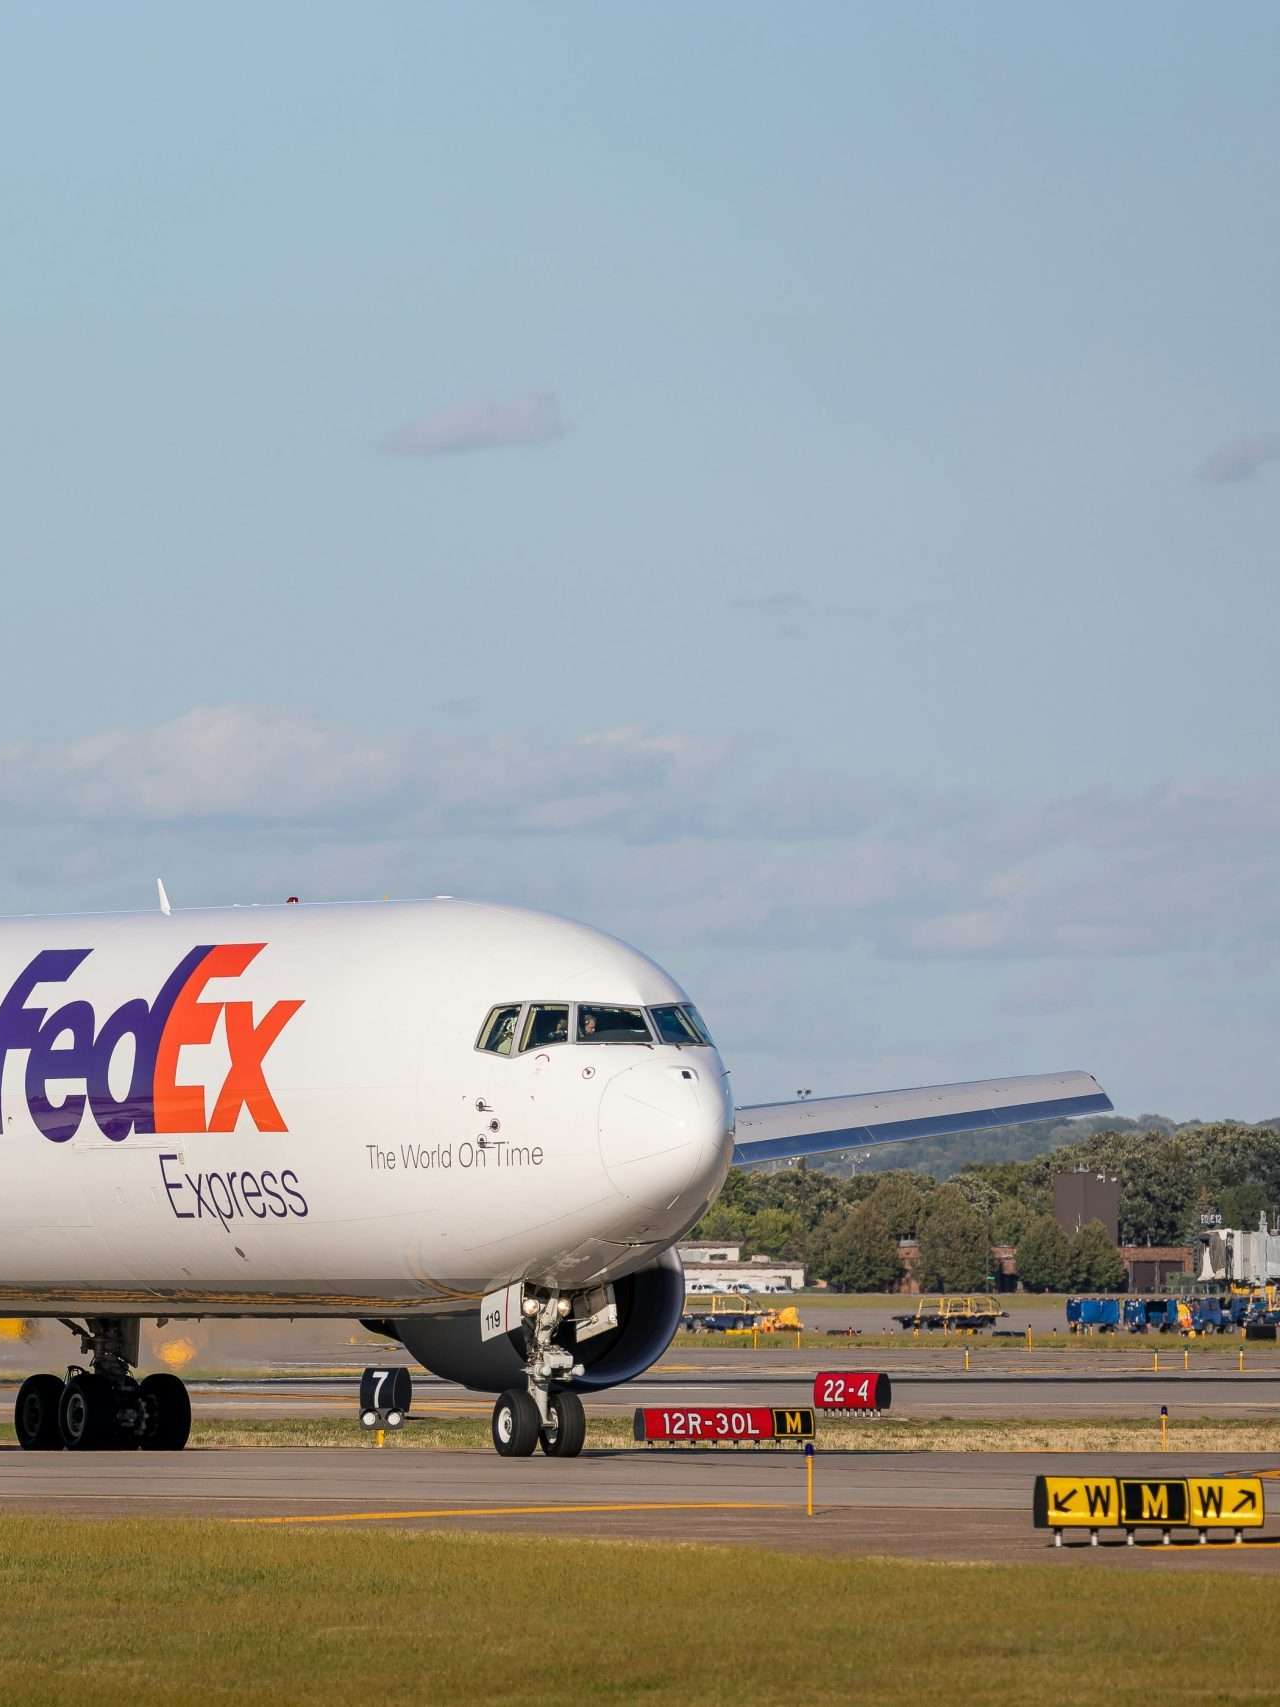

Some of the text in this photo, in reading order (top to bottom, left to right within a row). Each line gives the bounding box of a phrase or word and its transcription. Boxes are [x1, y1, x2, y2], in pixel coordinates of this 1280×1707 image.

[365, 1141, 544, 1170] The World On Time
[158, 1154, 309, 1234] Express
[485, 1310, 501, 1332] 119
[372, 1371, 389, 1409] 7
[823, 1379, 870, 1402] 22-4
[662, 1411, 802, 1435] 12R-30L M
[1084, 1484, 1224, 1519] W M W
